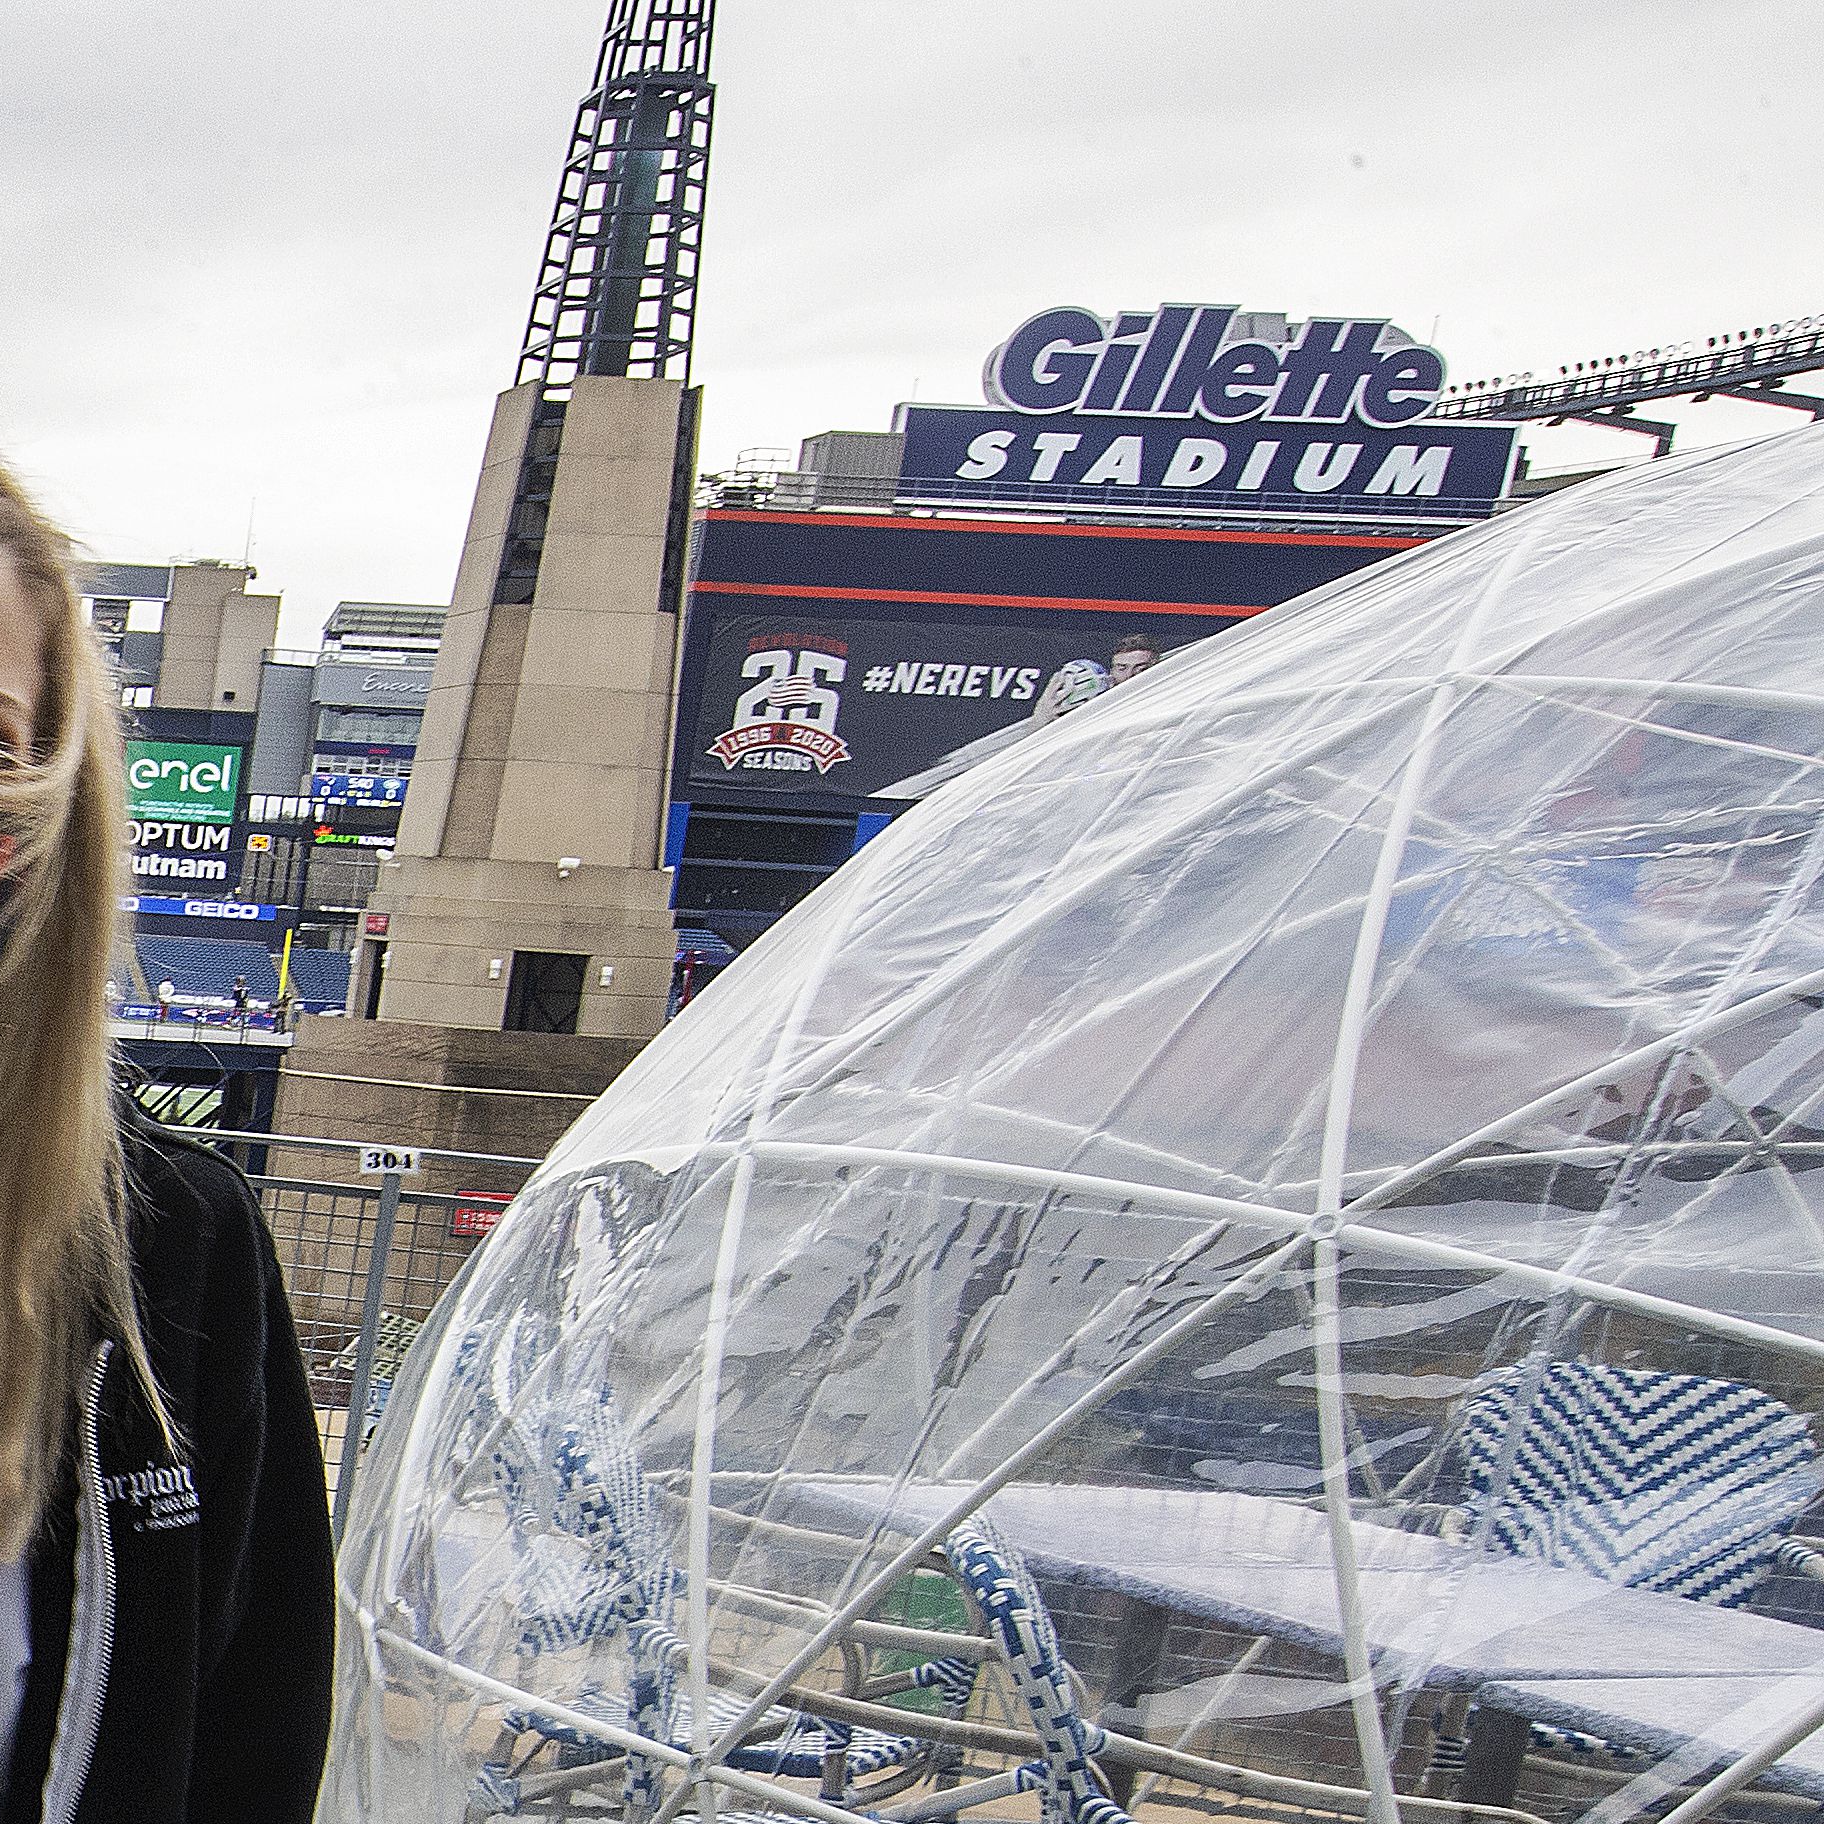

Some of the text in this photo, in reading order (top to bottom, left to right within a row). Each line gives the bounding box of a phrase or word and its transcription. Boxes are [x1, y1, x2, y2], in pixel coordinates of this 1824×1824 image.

[997, 303, 1448, 430] Gillette
[955, 430, 1455, 498] STADIUM
[362, 671, 431, 694] Encore
[732, 650, 850, 735] 25
[862, 661, 1041, 701] #NEREVS
[790, 728, 835, 755] 2020
[129, 755, 233, 793] enel
[743, 751, 815, 772] SEASONS
[127, 820, 231, 851] OPTUM
[131, 853, 227, 880] utnam
[184, 901, 259, 919] GEICO
[366, 1152, 412, 1169] 304
[102, 1460, 195, 1507] orpion
